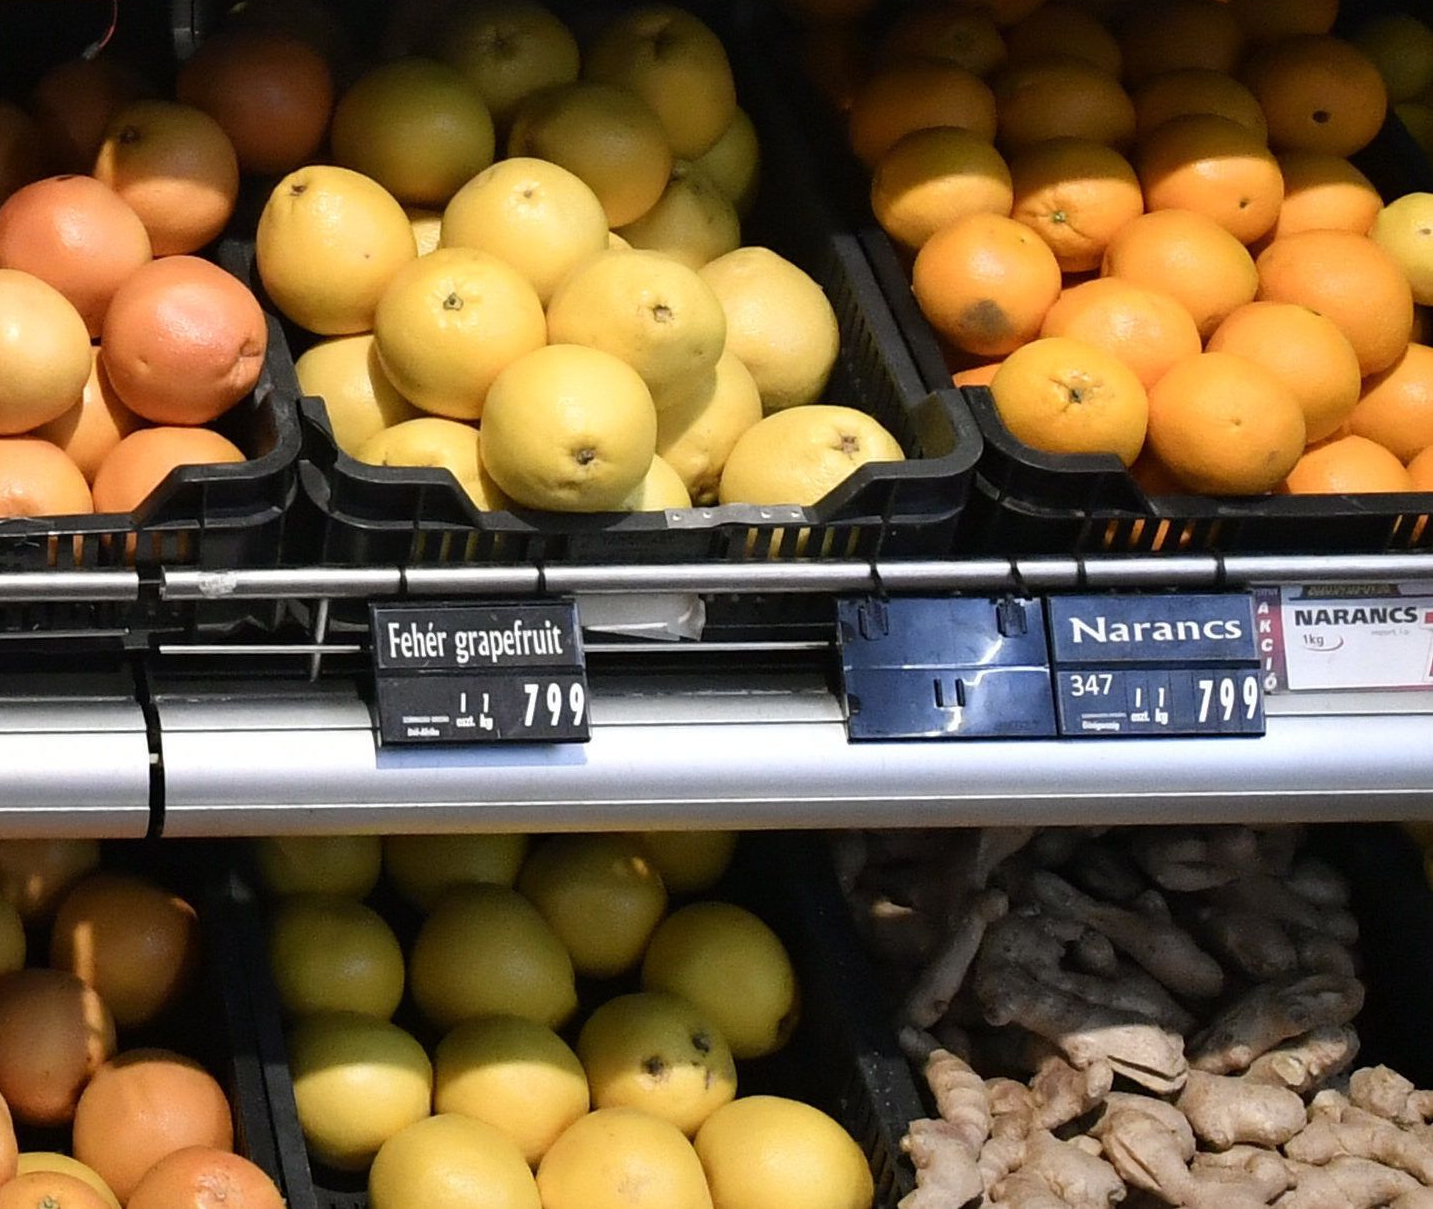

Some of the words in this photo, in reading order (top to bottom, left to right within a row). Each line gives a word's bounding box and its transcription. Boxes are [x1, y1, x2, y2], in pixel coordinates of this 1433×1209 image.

[1295, 606, 1418, 626] NARANCS
[1069, 616, 1242, 643] Narancs
[1303, 634, 1324, 647] 1kg
[388, 622, 447, 659] Fehér
[455, 620, 563, 664] grapefruit
[1070, 673, 1113, 697] 347
[524, 682, 585, 727] 799
[1198, 676, 1258, 723] 799
[479, 713, 494, 731] kg
[1154, 708, 1169, 725] kg
